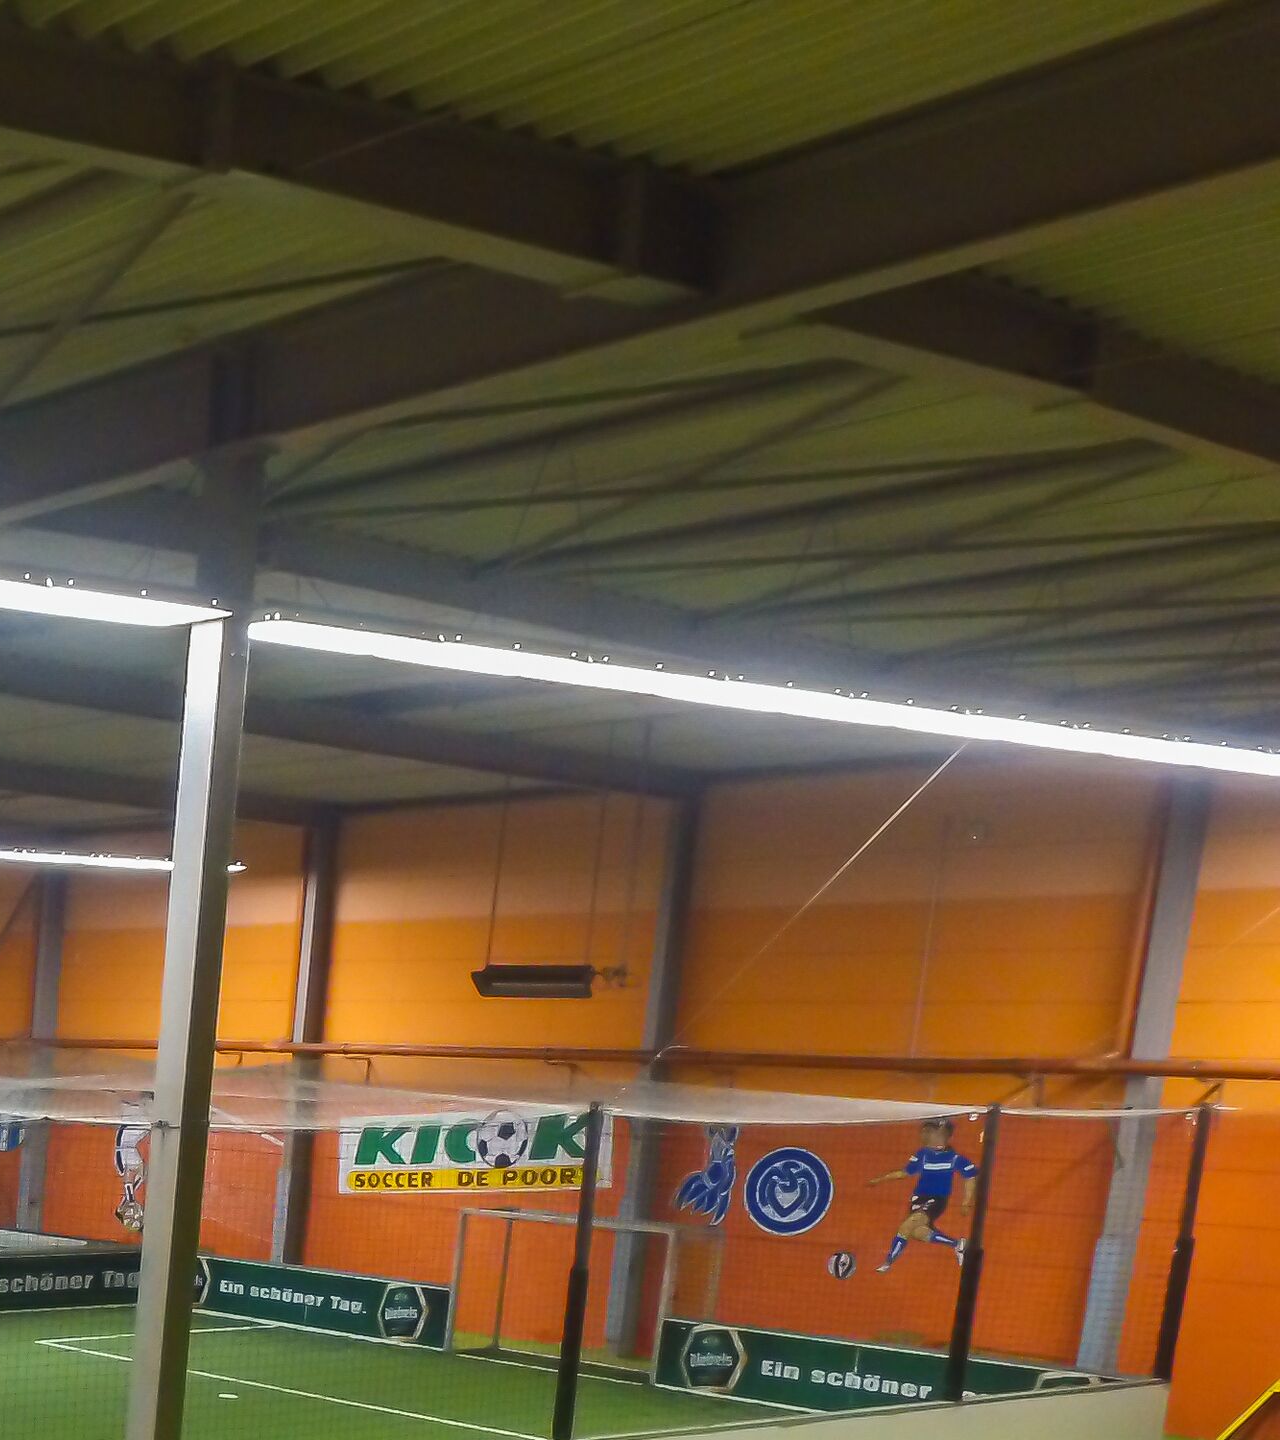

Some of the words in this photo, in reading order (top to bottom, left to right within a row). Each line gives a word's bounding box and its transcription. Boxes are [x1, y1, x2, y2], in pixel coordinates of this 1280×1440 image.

[354, 1170, 434, 1188] SOCCER
[457, 1171, 490, 1188] DE
[502, 1167, 584, 1187] POOR
[219, 1279, 244, 1296] Ein
[249, 1285, 325, 1308] schöner
[330, 1295, 367, 1314] Tag.
[760, 1359, 801, 1381] Ein
[810, 1369, 933, 1400] schöner
